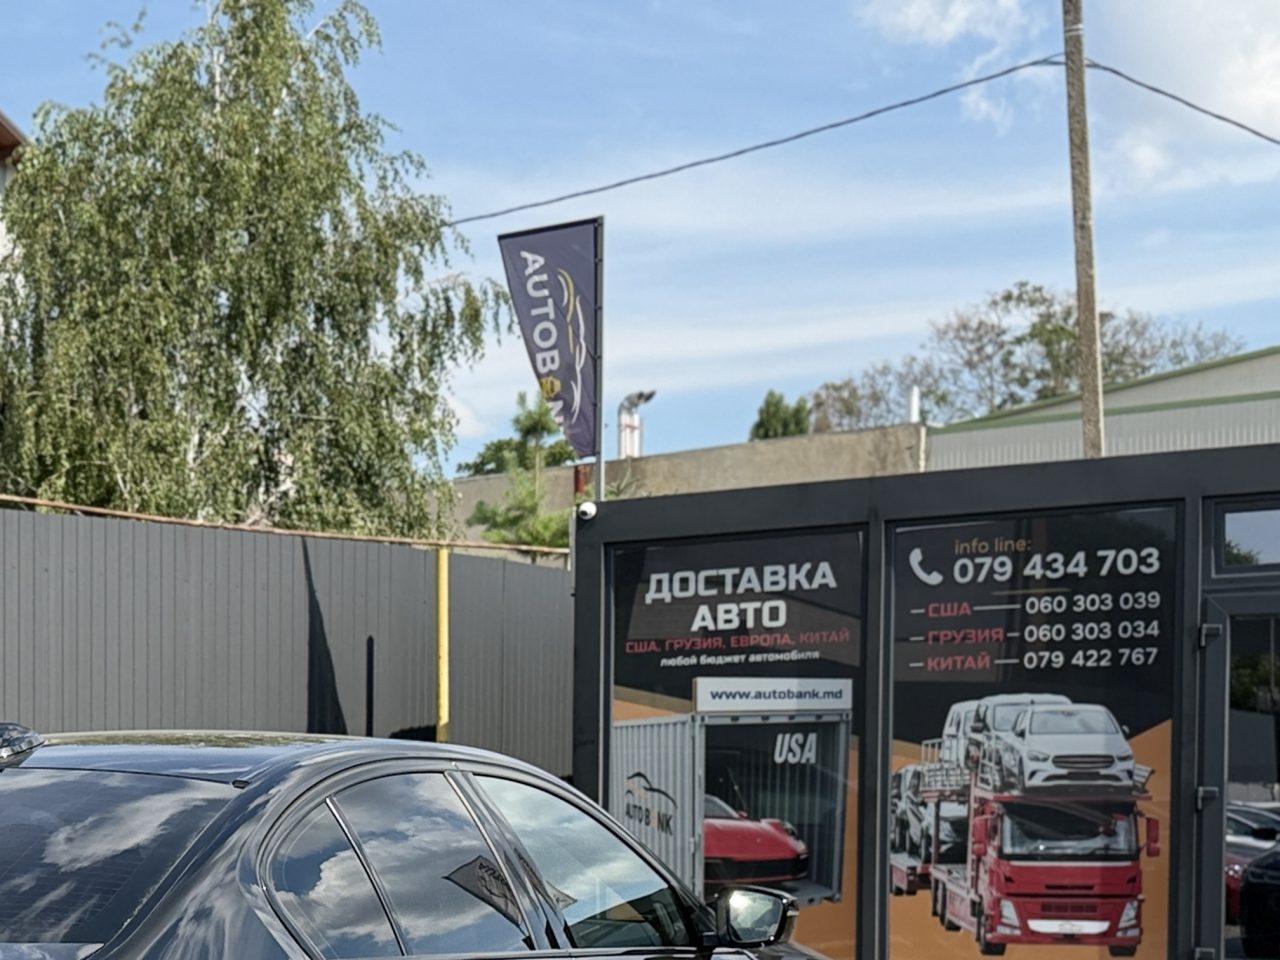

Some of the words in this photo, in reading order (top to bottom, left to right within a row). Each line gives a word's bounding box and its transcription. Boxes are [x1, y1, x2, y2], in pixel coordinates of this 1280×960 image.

[954, 538, 989, 555] info
[994, 537, 1032, 552] line:
[953, 555, 1013, 584] 079
[1023, 551, 1088, 580] 434
[1096, 547, 1160, 576] 703
[645, 561, 837, 604] ДОСТАВКА
[690, 600, 787, 632] АВТО
[927, 602, 972, 618] США
[1025, 596, 1067, 614] 060
[1072, 593, 1113, 612] 303
[1119, 591, 1161, 609] 039
[800, 628, 850, 643] КИТАЙ
[927, 628, 1004, 645] ГРУЗИЯ
[1024, 624, 1066, 642] 060
[1071, 622, 1112, 640] 303
[1118, 620, 1160, 638] 034
[660, 654, 697, 667] любой
[700, 653, 746, 666] бюджет
[749, 649, 820, 663] автомобиля
[927, 652, 991, 671] КИТАЙ
[1023, 651, 1064, 669] 079
[1070, 649, 1111, 667] 422
[1118, 647, 1158, 665] 767
[710, 688, 843, 701] www.autobank.md
[774, 732, 818, 764] USA
